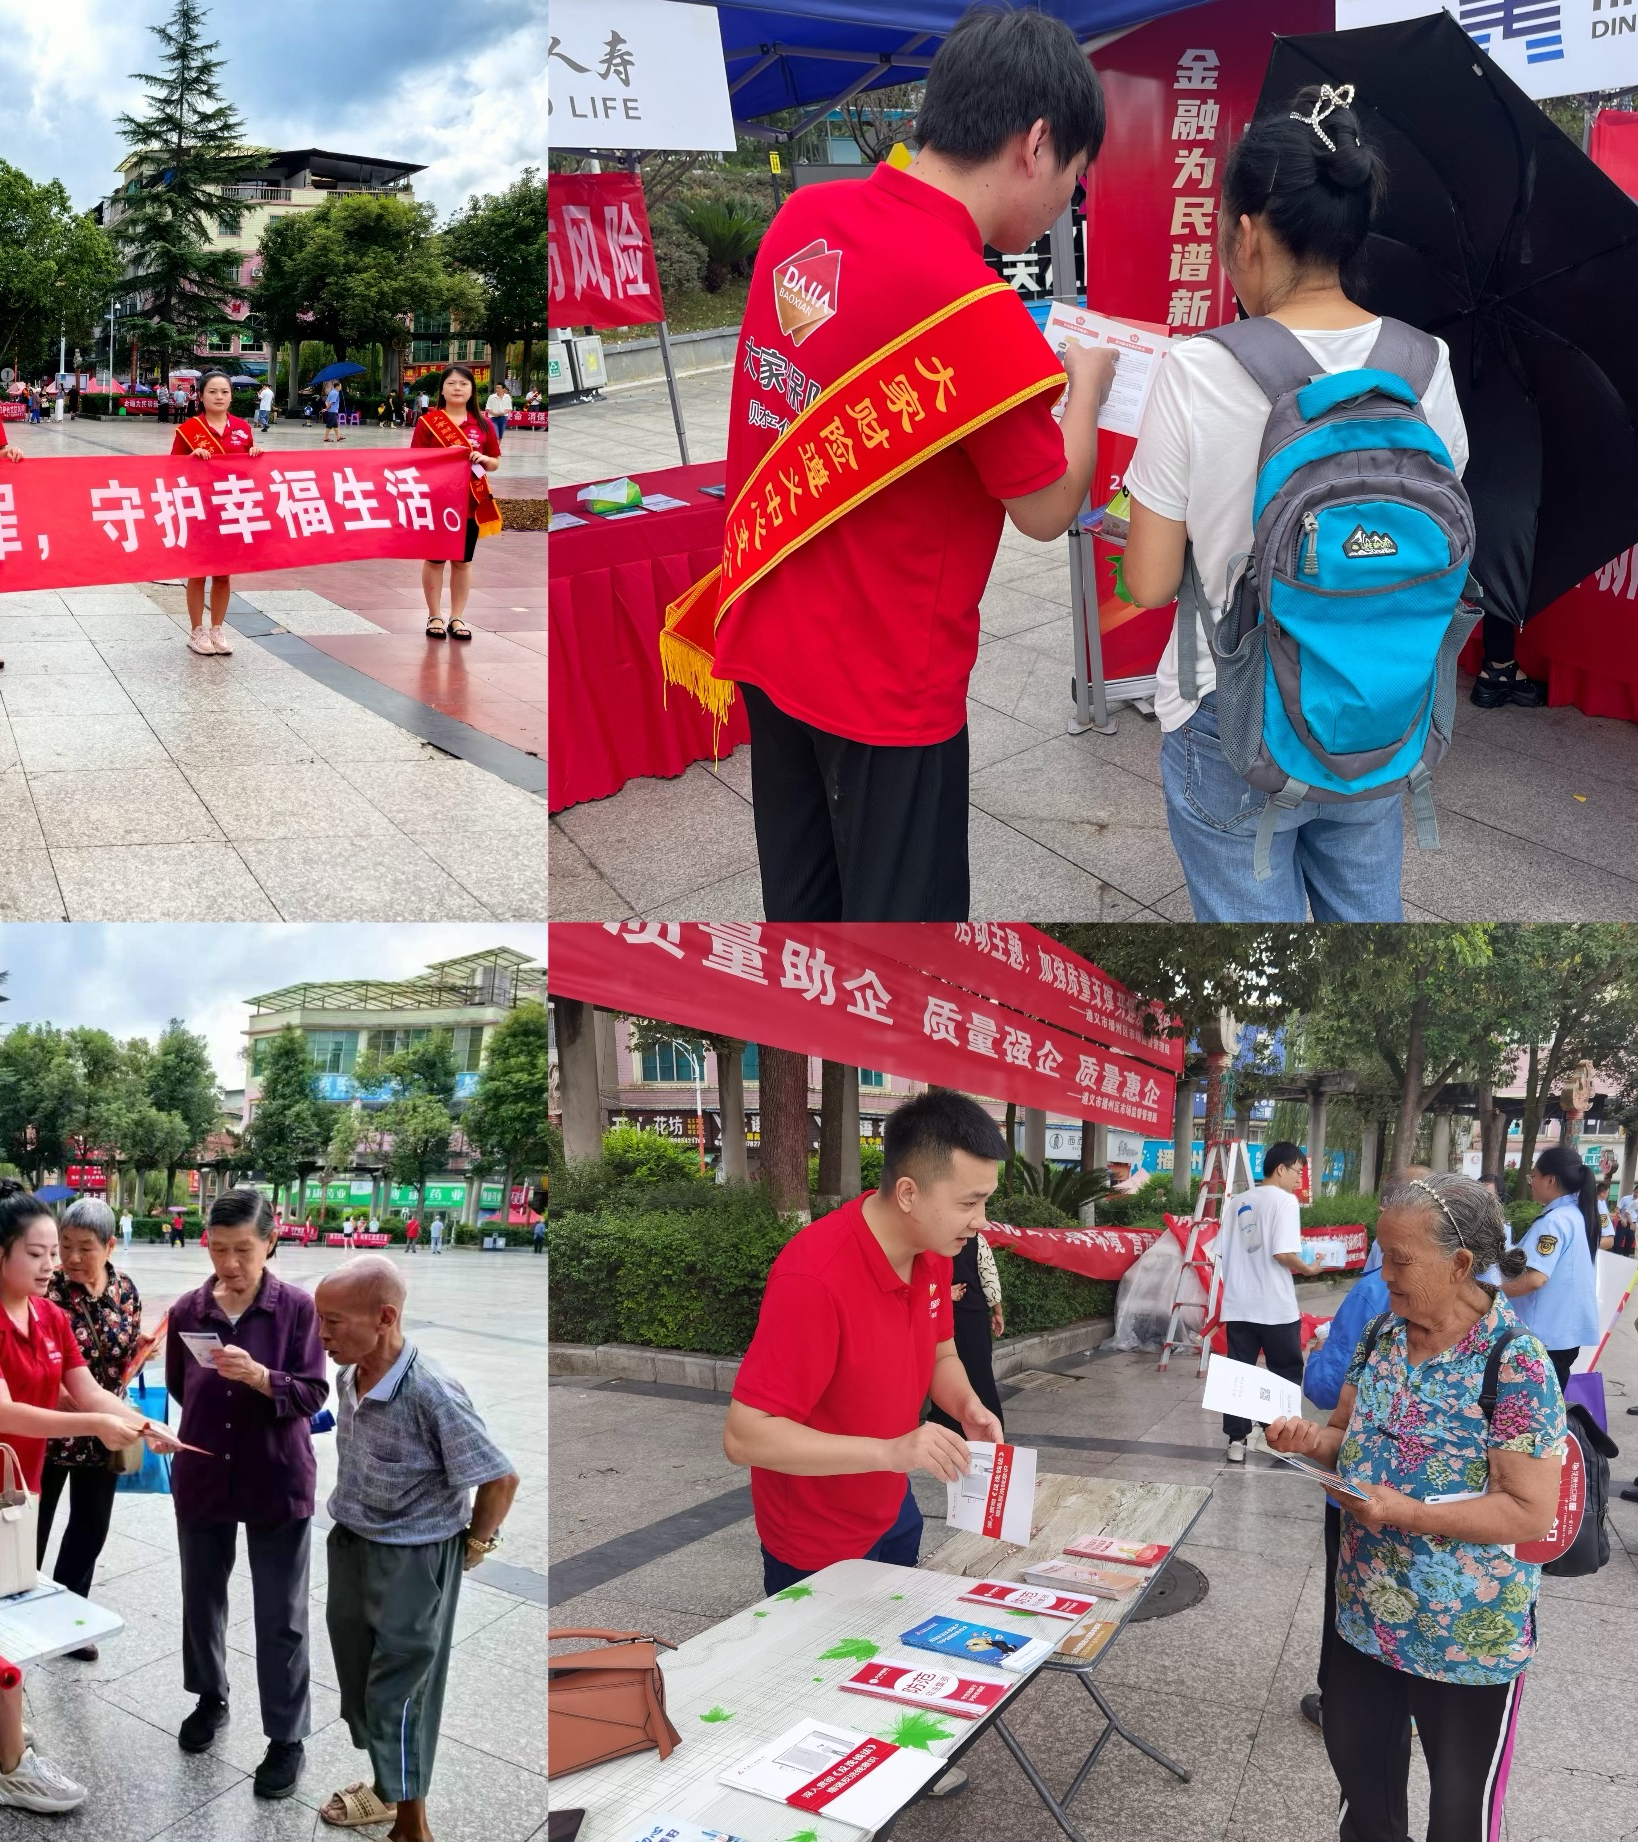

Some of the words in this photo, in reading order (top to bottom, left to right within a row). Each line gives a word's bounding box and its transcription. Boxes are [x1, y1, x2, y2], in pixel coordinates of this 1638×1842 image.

[548, 30, 636, 88] 人寿
[569, 96, 642, 121] LIFE
[1166, 48, 1221, 338] 金融为民谱新
[778, 288, 813, 317] BAOXIAN
[783, 266, 832, 313] DAJIA
[527, 412, 548, 422] 消保
[922, 996, 1064, 1079] 质量强企
[1075, 1053, 1161, 1109] 质量惠企
[901, 1671, 938, 1694] 防范
